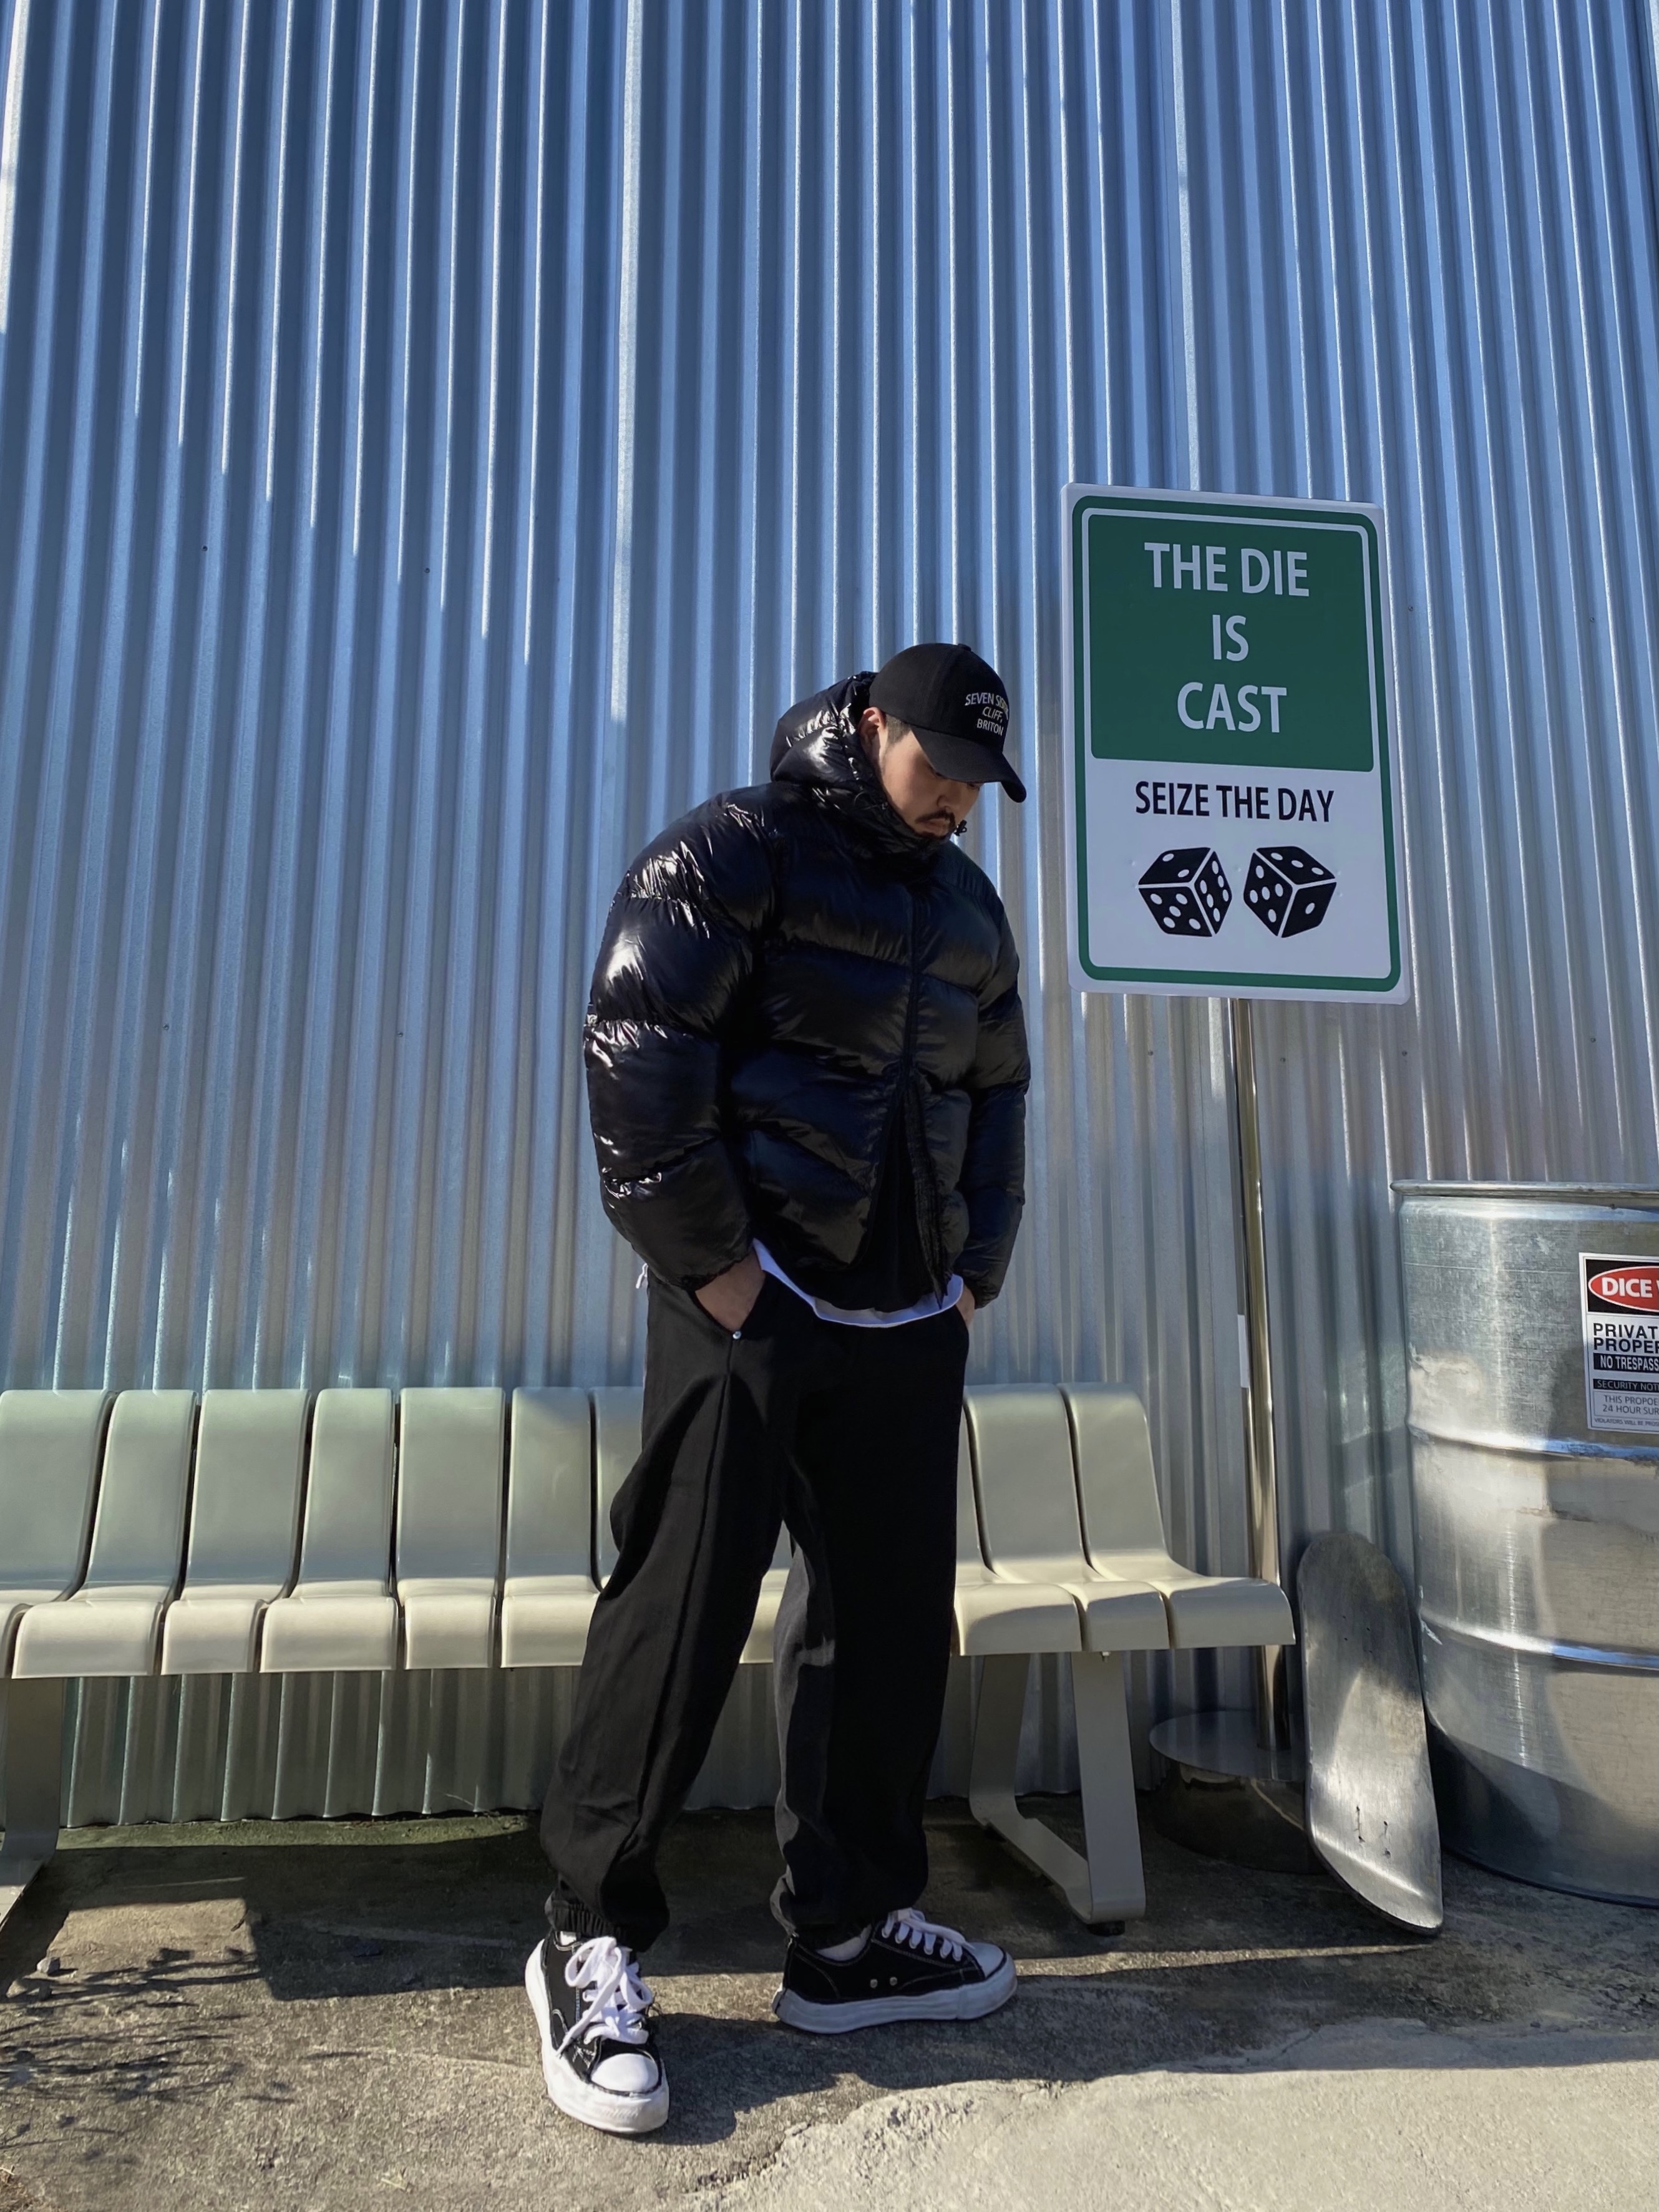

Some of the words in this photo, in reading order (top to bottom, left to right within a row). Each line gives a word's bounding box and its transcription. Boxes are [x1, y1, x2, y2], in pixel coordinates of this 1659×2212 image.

[1144, 541, 1228, 592] THE
[1241, 548, 1310, 597] DIE
[1212, 614, 1249, 661] IS
[965, 692, 994, 706] SEVEN
[1177, 681, 1287, 733] CAST
[976, 718, 1004, 736] BRITON
[1135, 780, 1210, 817] SEIZE
[1216, 784, 1270, 820] THE
[1278, 788, 1335, 822] DAY
[1602, 1277, 1653, 1298] DICE
[1600, 1355, 1613, 1369] NO
[1597, 1380, 1638, 1390] SECURITY
[1603, 1395, 1622, 1404] THIS
[1616, 1405, 1641, 1414] HOUR
